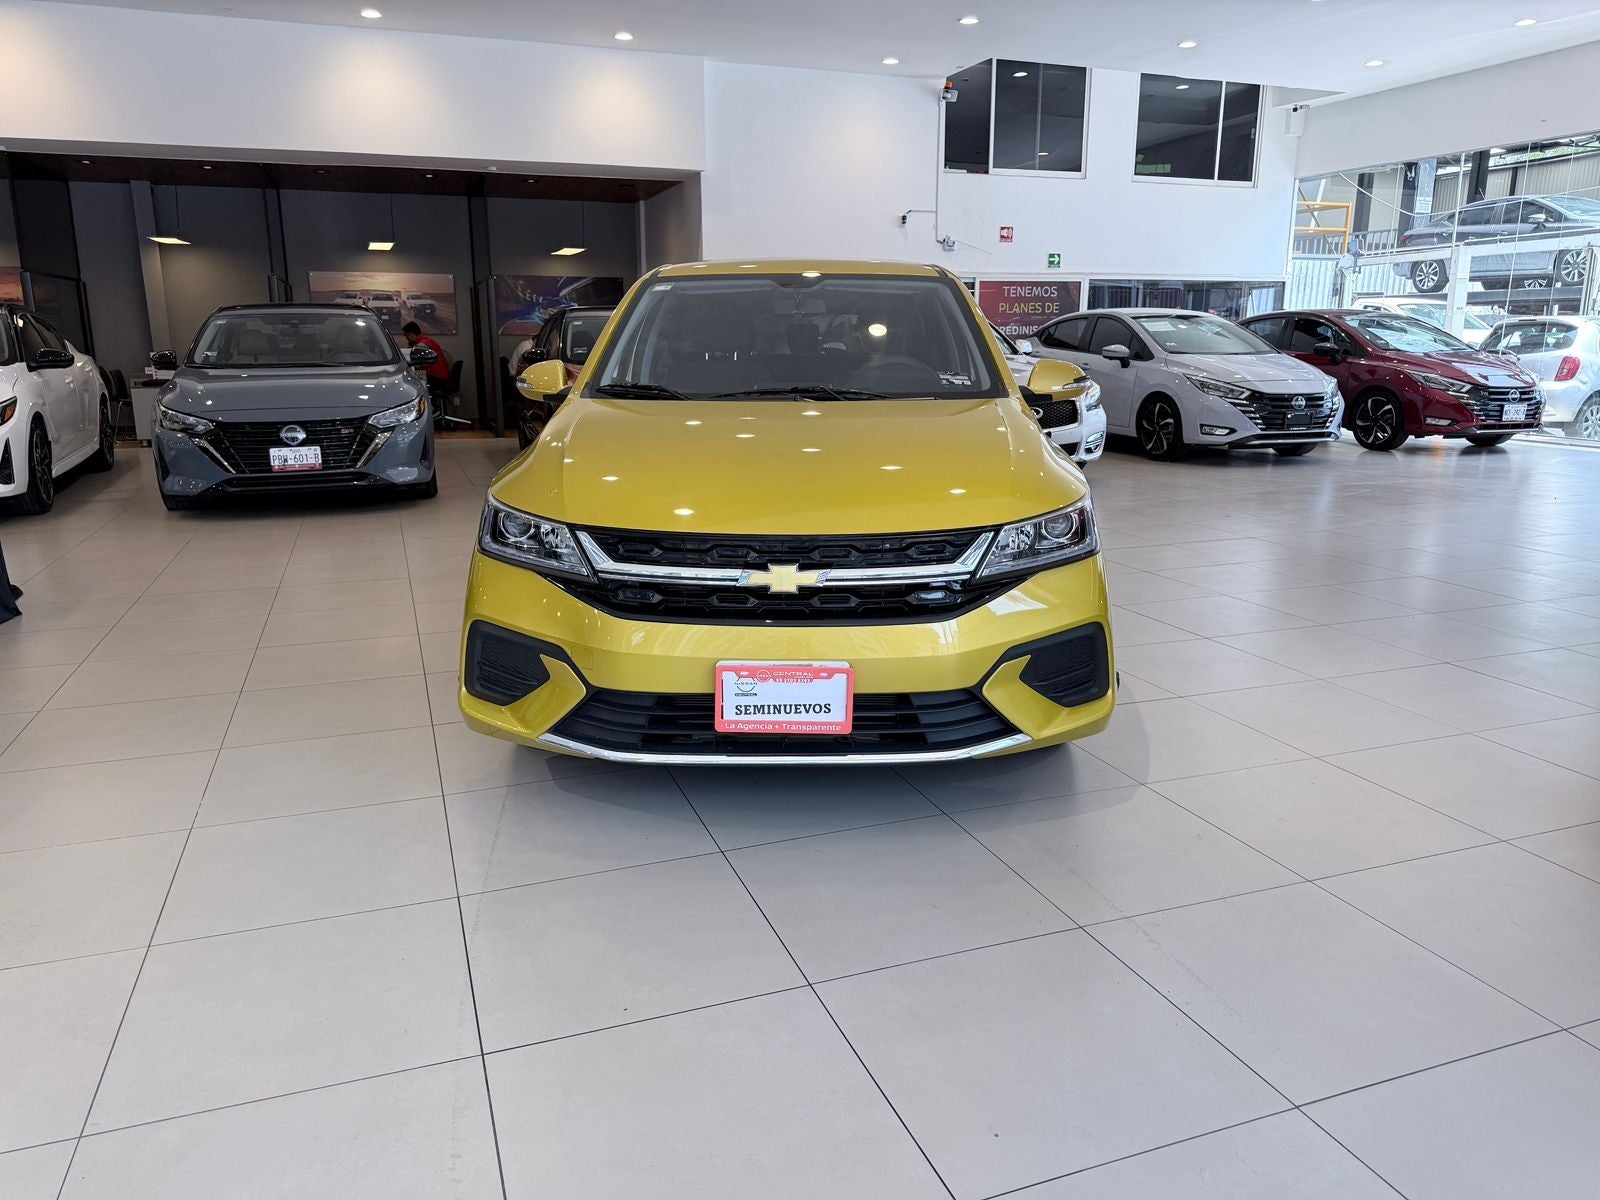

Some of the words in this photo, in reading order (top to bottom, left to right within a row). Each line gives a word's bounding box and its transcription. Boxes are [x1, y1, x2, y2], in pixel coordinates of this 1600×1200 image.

[1002, 286, 1058, 297] TENEMOS
[999, 303, 1042, 313] PLANES
[1045, 303, 1060, 312] DE
[271, 452, 320, 464] PBW-601-B
[735, 703, 831, 715] SEMINUEVOS
[737, 722, 773, 730] Agencia
[782, 723, 842, 731] Transparente
